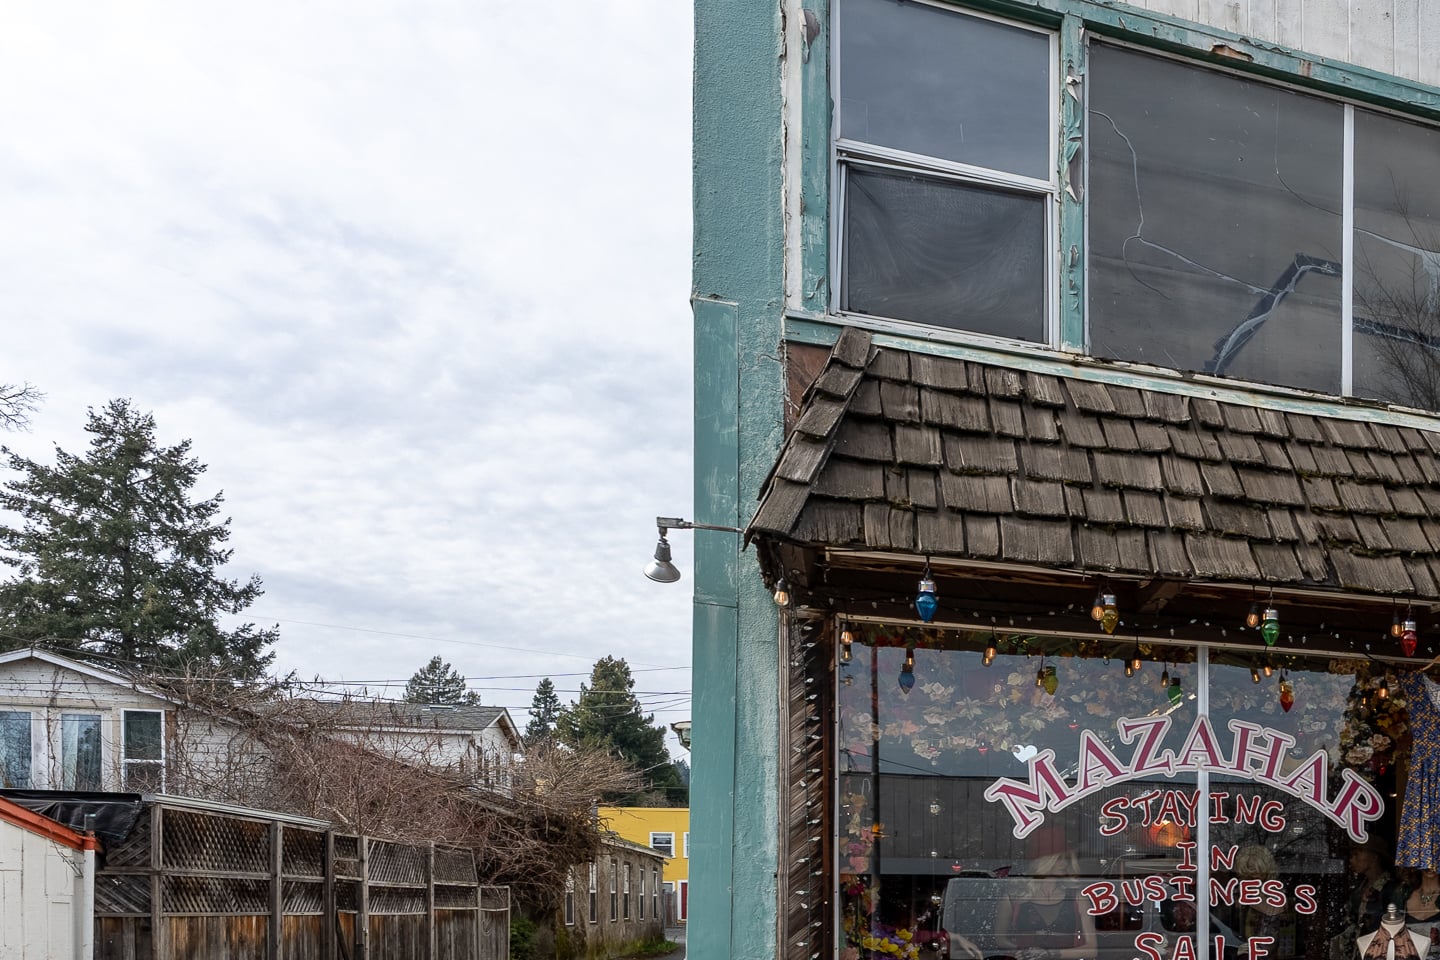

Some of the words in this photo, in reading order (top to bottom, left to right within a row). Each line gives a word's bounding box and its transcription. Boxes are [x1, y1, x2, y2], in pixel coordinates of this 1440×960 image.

[984, 714, 1385, 844] MAZAHAR
[1099, 789, 1287, 836] STAYING
[1174, 841, 1239, 873] IN
[1080, 875, 1318, 915] BUSINESS
